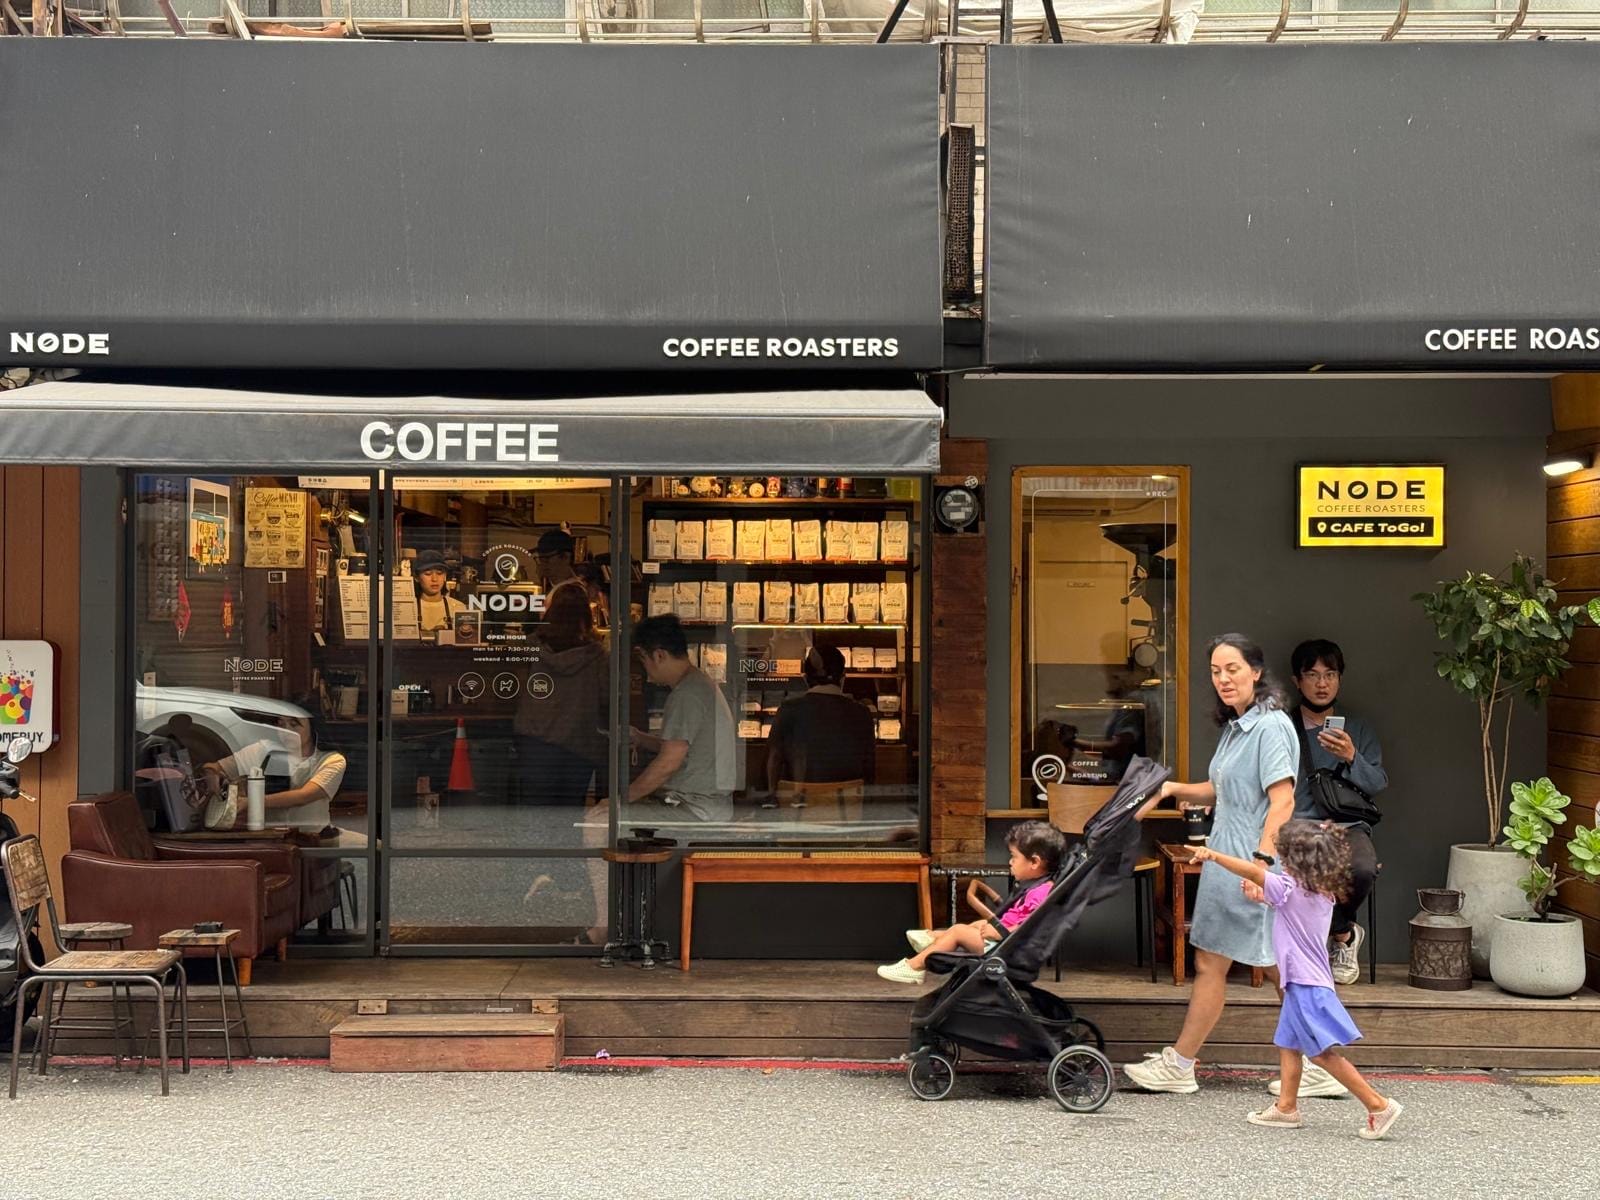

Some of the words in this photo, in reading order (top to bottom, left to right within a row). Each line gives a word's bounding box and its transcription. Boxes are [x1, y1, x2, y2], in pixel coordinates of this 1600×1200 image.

[9, 332, 110, 355] NODE
[662, 338, 760, 358] COFFEE
[766, 338, 899, 358] ROASTERS
[1424, 328, 1517, 351] COFFEE
[1529, 327, 1600, 350] ROAS
[360, 421, 559, 462] COFFEE
[1318, 480, 1425, 500] NODE
[1317, 504, 1361, 513] COFFEE
[1365, 504, 1426, 513] ROASTERS
[1330, 522, 1374, 533] CAFE
[1378, 522, 1425, 533] ToGo!
[468, 594, 546, 612] NODE
[224, 659, 283, 672] NODE
